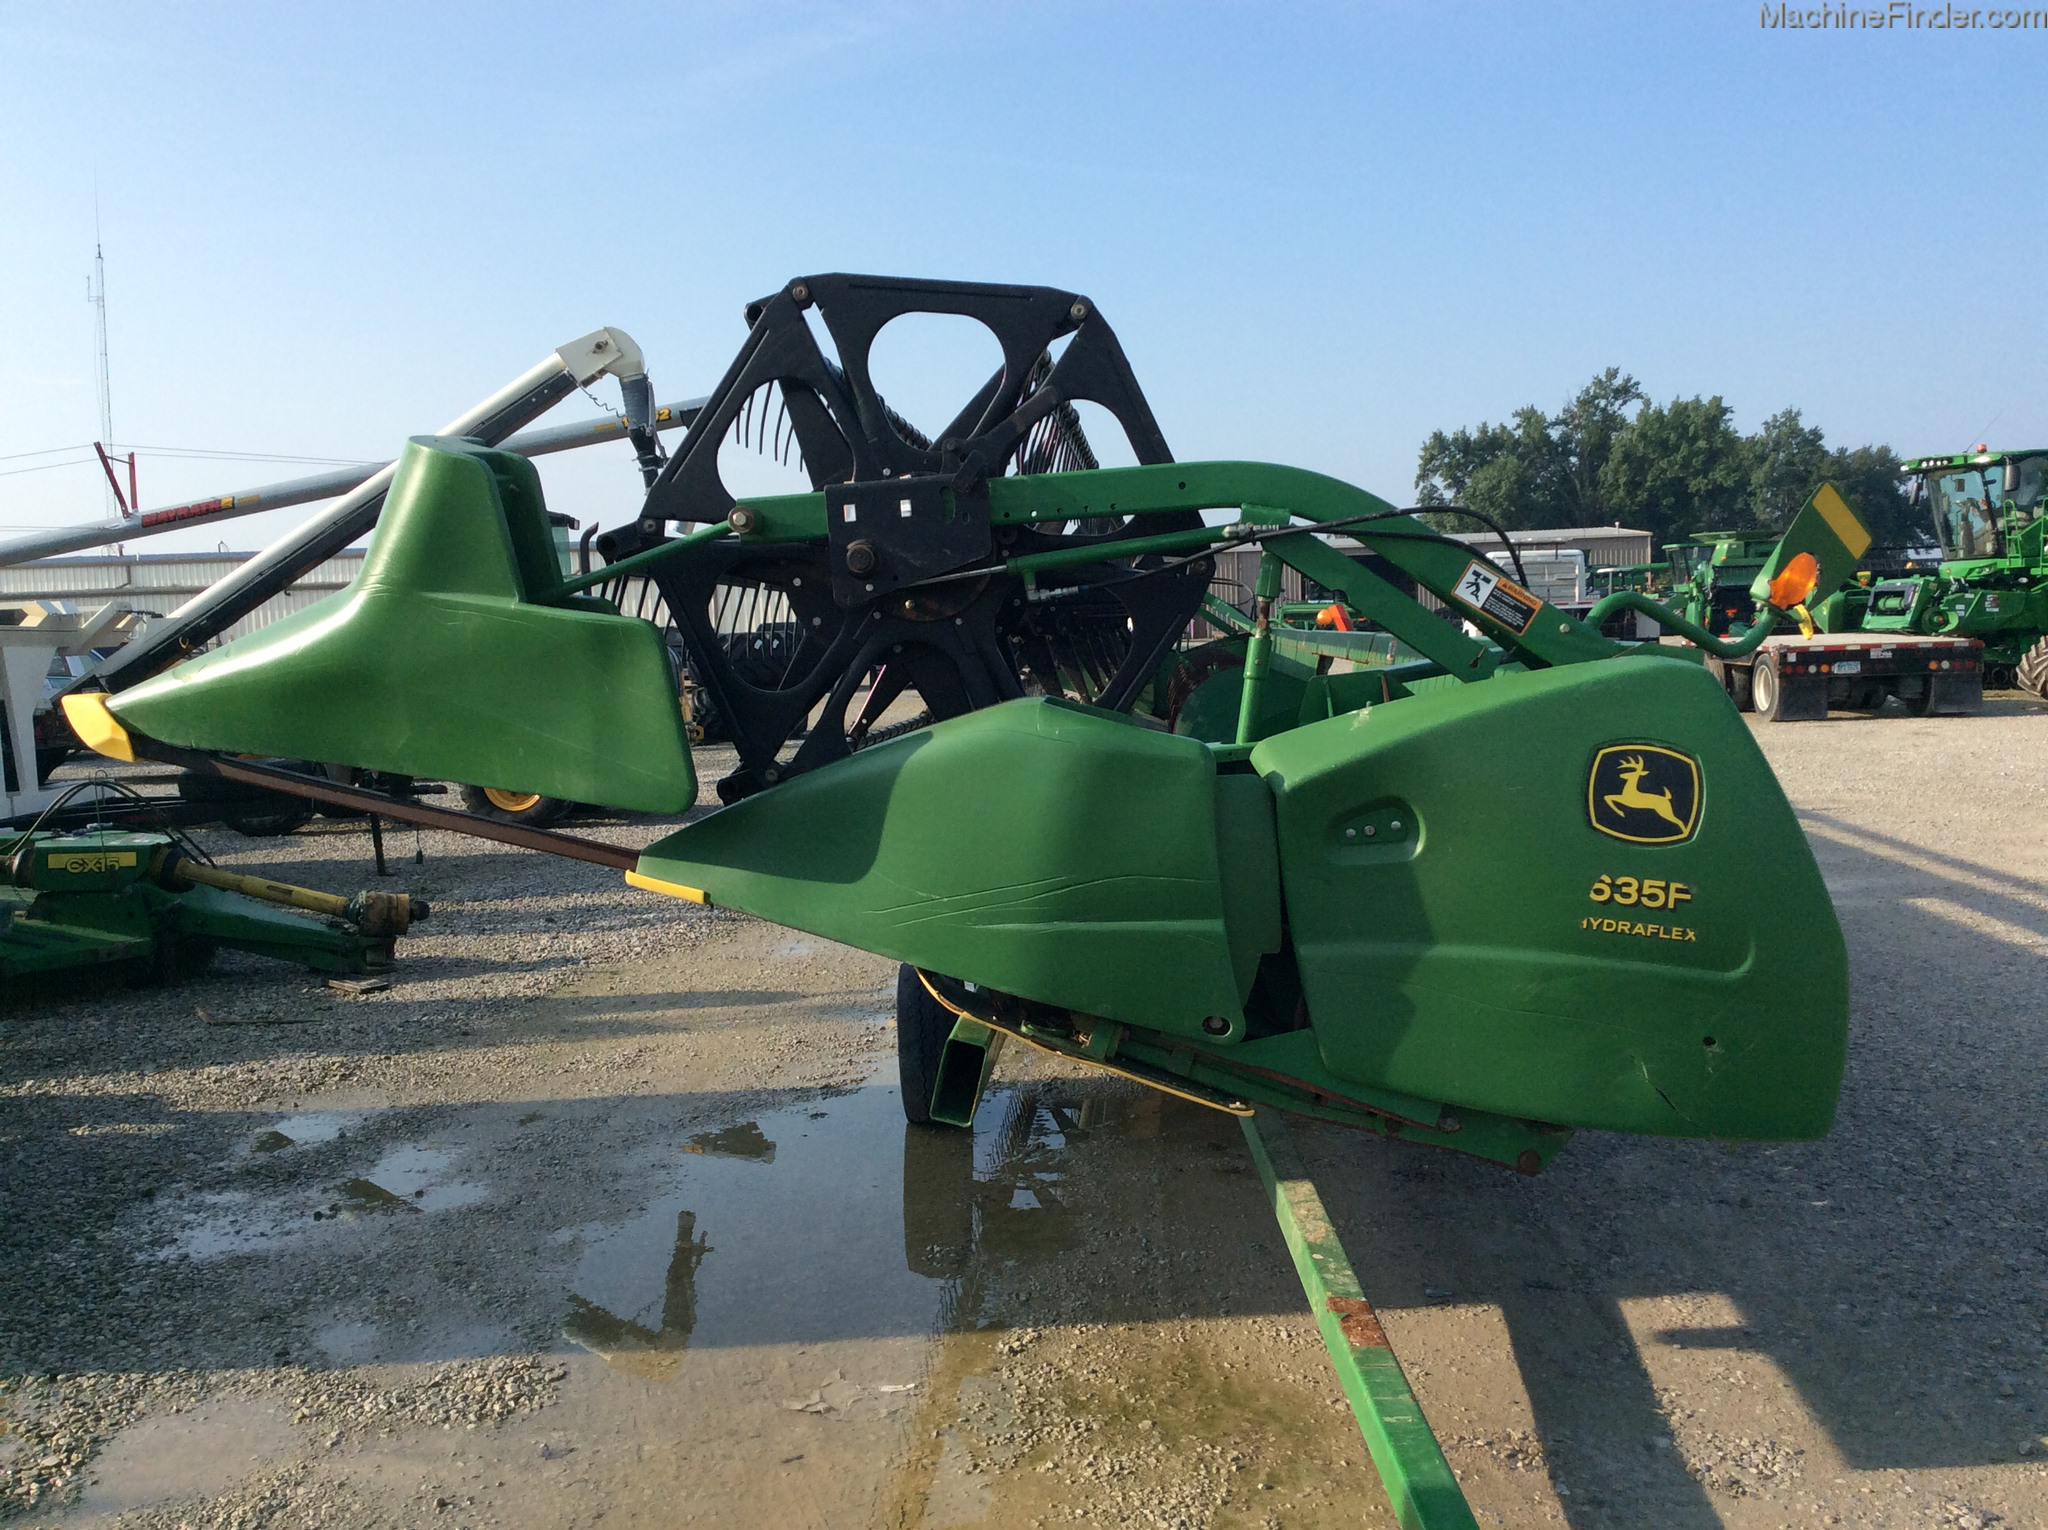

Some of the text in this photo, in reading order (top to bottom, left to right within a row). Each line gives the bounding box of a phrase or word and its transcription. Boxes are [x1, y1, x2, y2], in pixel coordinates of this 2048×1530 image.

[1505, 583, 1538, 606] WARNING
[65, 857, 120, 873] CX15
[1588, 873, 1693, 911] 635F
